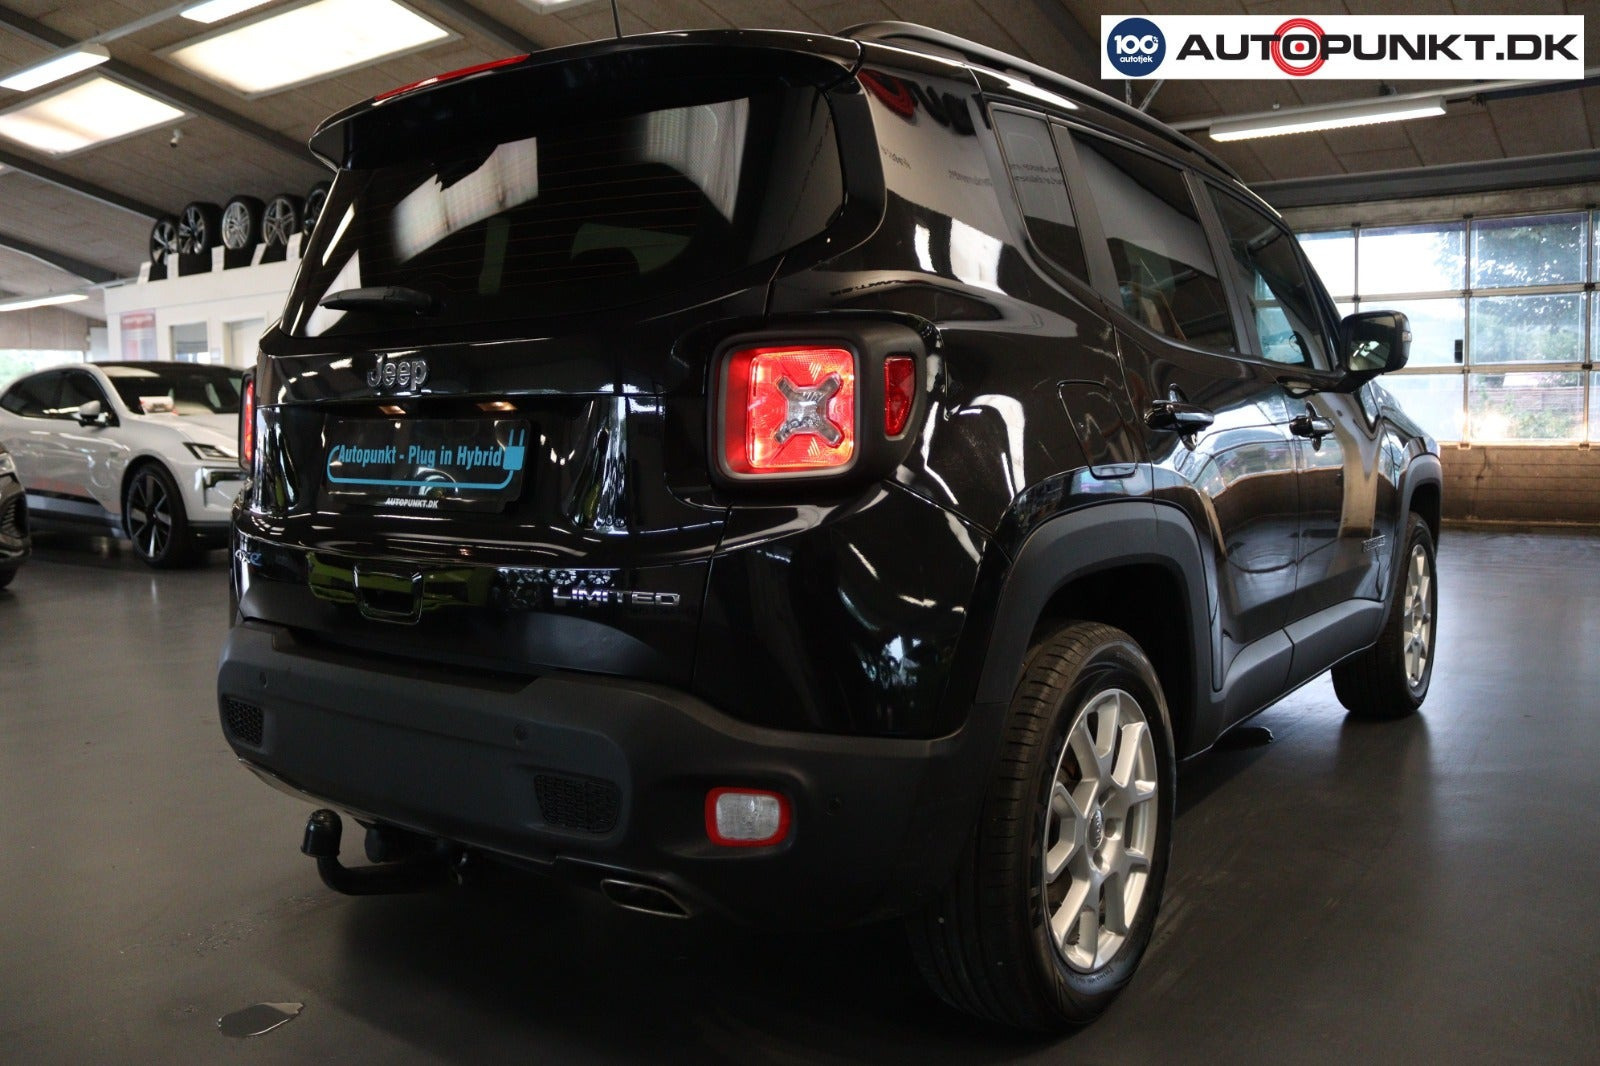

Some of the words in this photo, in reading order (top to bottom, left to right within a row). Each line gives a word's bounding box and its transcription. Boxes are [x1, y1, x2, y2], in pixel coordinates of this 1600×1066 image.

[367, 354, 428, 391] Jeep
[338, 444, 396, 468] Autopunkt
[408, 445, 436, 468] Plug
[440, 446, 453, 466] in
[457, 447, 502, 470] Hybrid
[385, 497, 439, 509] AUTOPUNKT.DK
[552, 587, 680, 605] LIMITED
